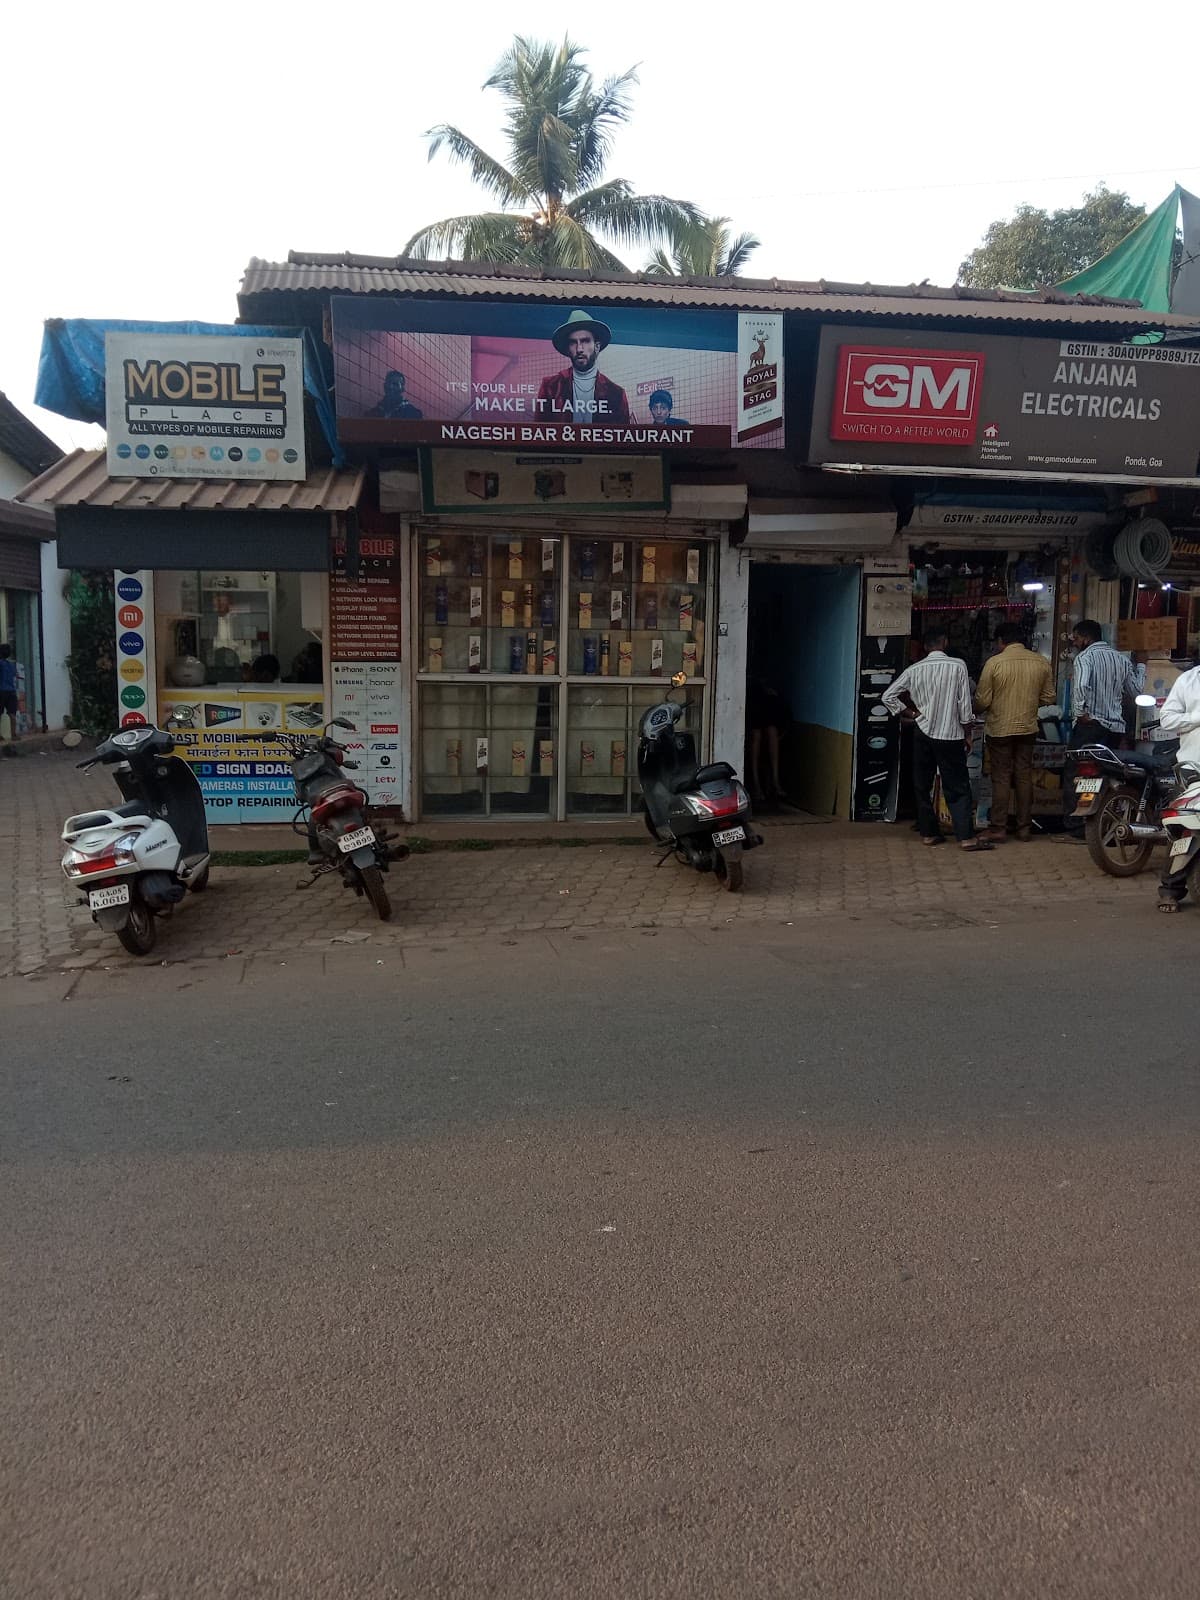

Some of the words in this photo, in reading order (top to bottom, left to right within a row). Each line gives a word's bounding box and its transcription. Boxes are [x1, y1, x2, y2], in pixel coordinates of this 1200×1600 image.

[1067, 344, 1098, 357] GSTIN
[1108, 346, 1200, 364] 30AQVPP8989J1Z
[746, 368, 776, 386] ROYAL
[1053, 361, 1138, 388] ANJANA
[125, 361, 284, 404] MOBILE
[446, 382, 468, 392] IT'S
[472, 383, 506, 394] YOUR
[509, 384, 538, 394] LIFE.
[862, 364, 971, 411] GM
[748, 390, 772, 405] STAG
[474, 398, 526, 413] MAKE
[532, 399, 547, 413] IT
[551, 399, 613, 415] LARGE.
[1020, 392, 1162, 421] ELECTRICALS
[140, 408, 273, 422] PLACE
[131, 424, 148, 432] ALL
[150, 424, 180, 432] TYPES
[182, 425, 196, 433] OF
[197, 426, 231, 434] MOBILE
[233, 427, 282, 436] REPAIRING
[441, 425, 516, 442] NAGESH
[522, 427, 558, 442] BAR
[562, 426, 576, 442] &
[580, 427, 694, 444] RESTAURANT
[842, 423, 877, 435] SWITCH
[880, 425, 892, 435] TO
[904, 426, 934, 437] BETTER
[936, 427, 969, 439] WORLD
[981, 446, 998, 454] Home
[982, 438, 1010, 448] Intelligent
[980, 453, 1012, 462] Automation
[1027, 456, 1097, 465] www.gmmodular.com
[1124, 456, 1148, 468] Ponda,
[1149, 458, 1163, 467] Goa
[943, 513, 974, 524] GSTIN
[336, 539, 394, 555] MBILE
[194, 764, 212, 774] ED
[216, 764, 250, 774] SIGN
[256, 764, 294, 774] BOAR
[248, 781, 296, 791] INSTALLA
[204, 798, 233, 807] PTOP
[238, 798, 304, 807] REPAIRING
